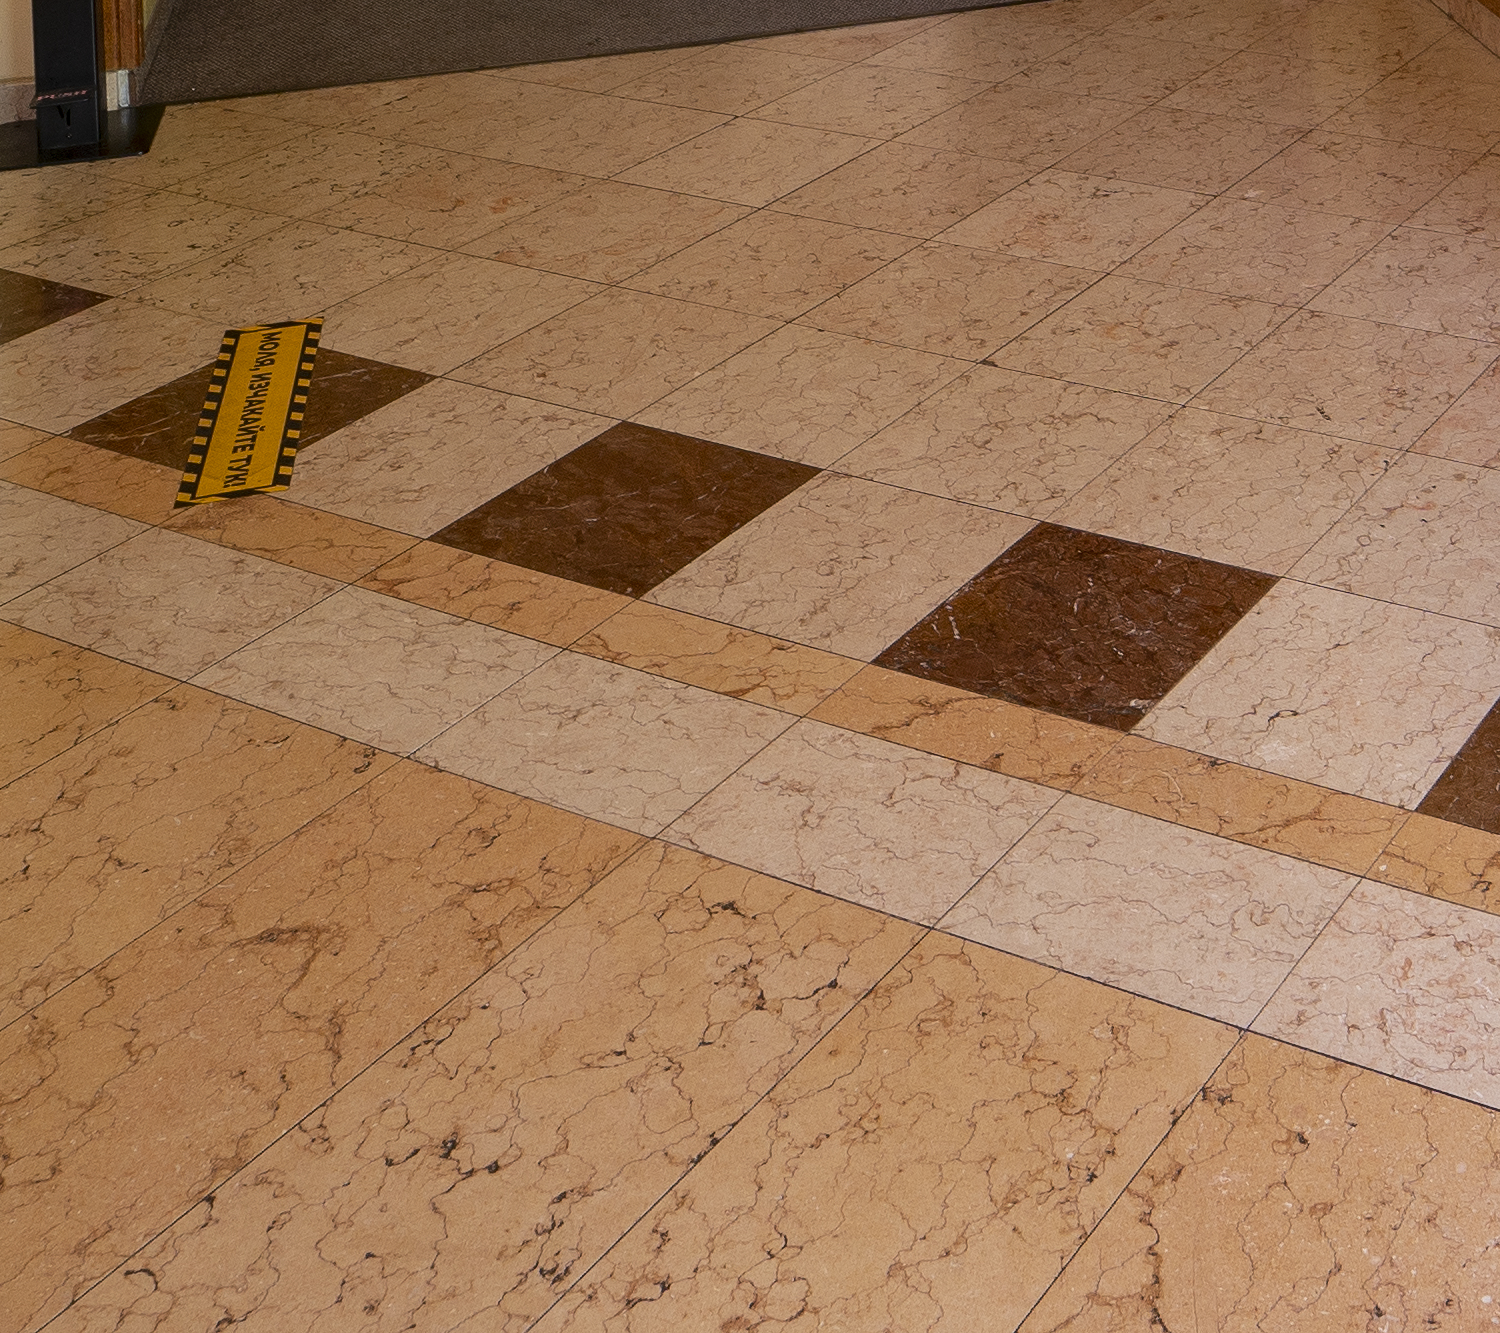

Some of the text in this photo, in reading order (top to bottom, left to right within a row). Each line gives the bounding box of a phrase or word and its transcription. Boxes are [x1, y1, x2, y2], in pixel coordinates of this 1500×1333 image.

[223, 331, 282, 488] МОЛЯ, ИЗЧАКАЙТЕ ТУК!
